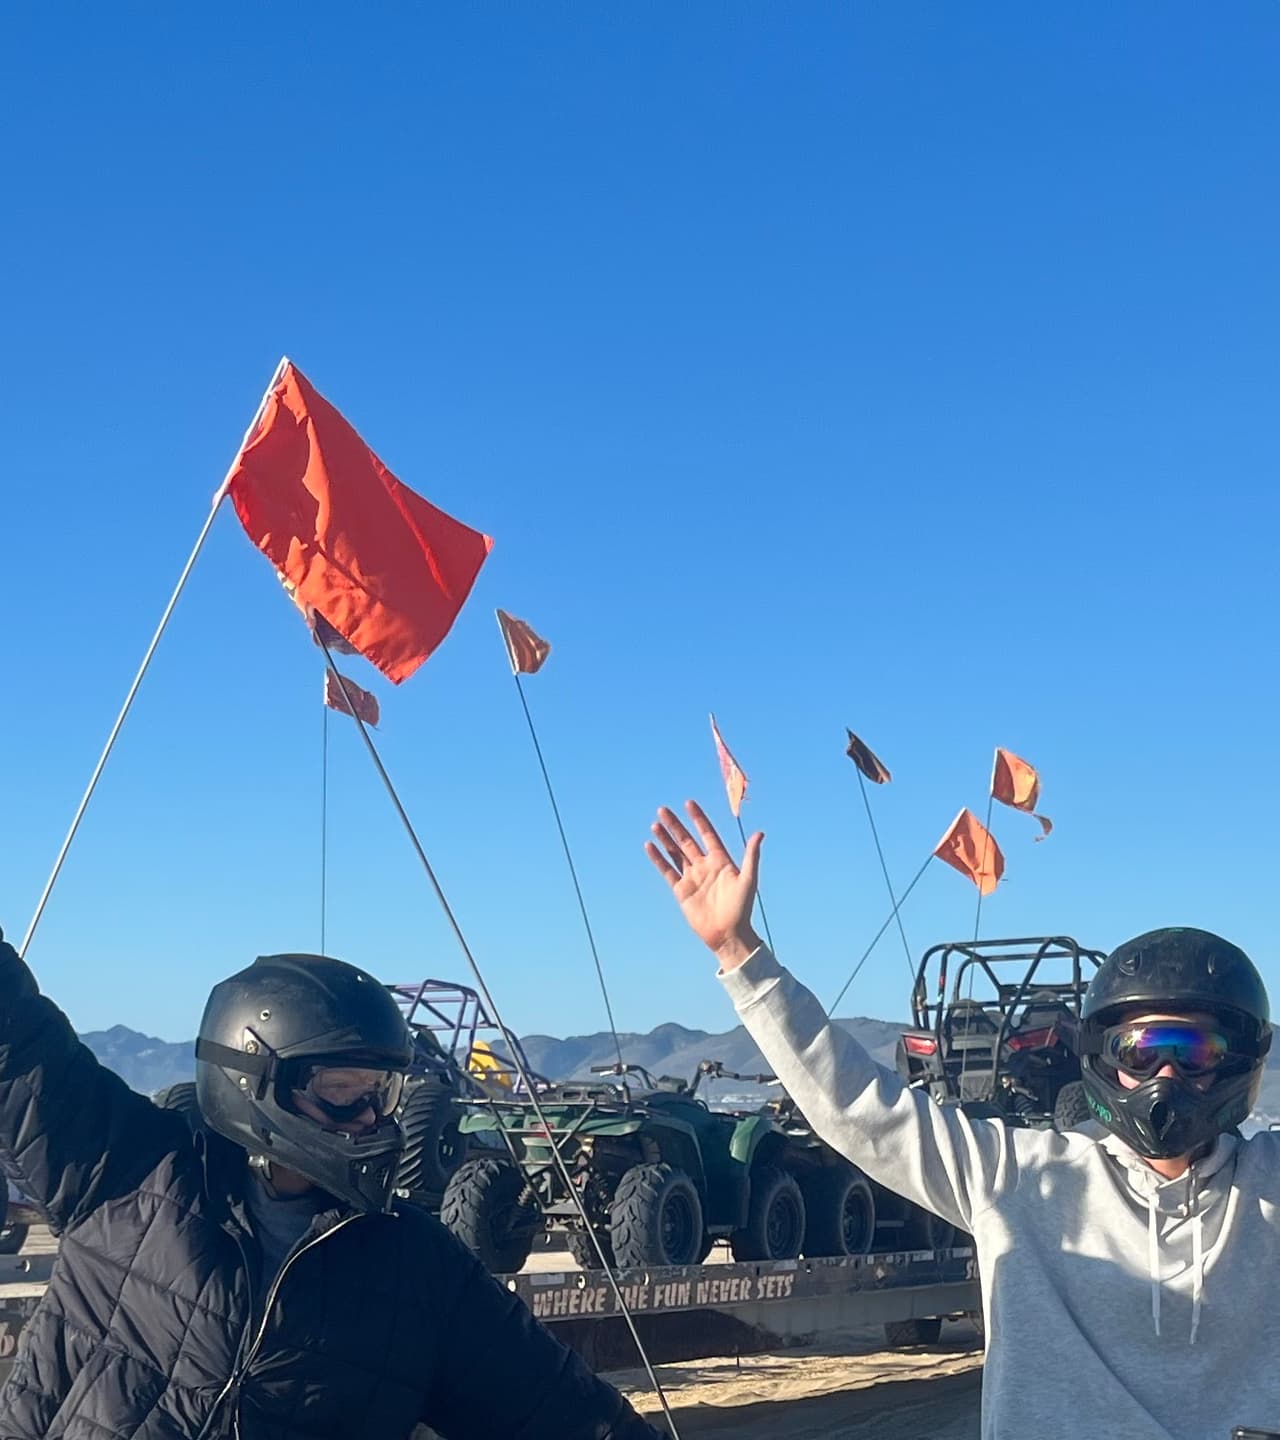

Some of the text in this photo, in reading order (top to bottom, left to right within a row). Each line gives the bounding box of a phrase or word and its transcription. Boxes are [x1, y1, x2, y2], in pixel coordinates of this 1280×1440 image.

[533, 1274, 795, 1317] WHERE THE FUN NEVER SETS
